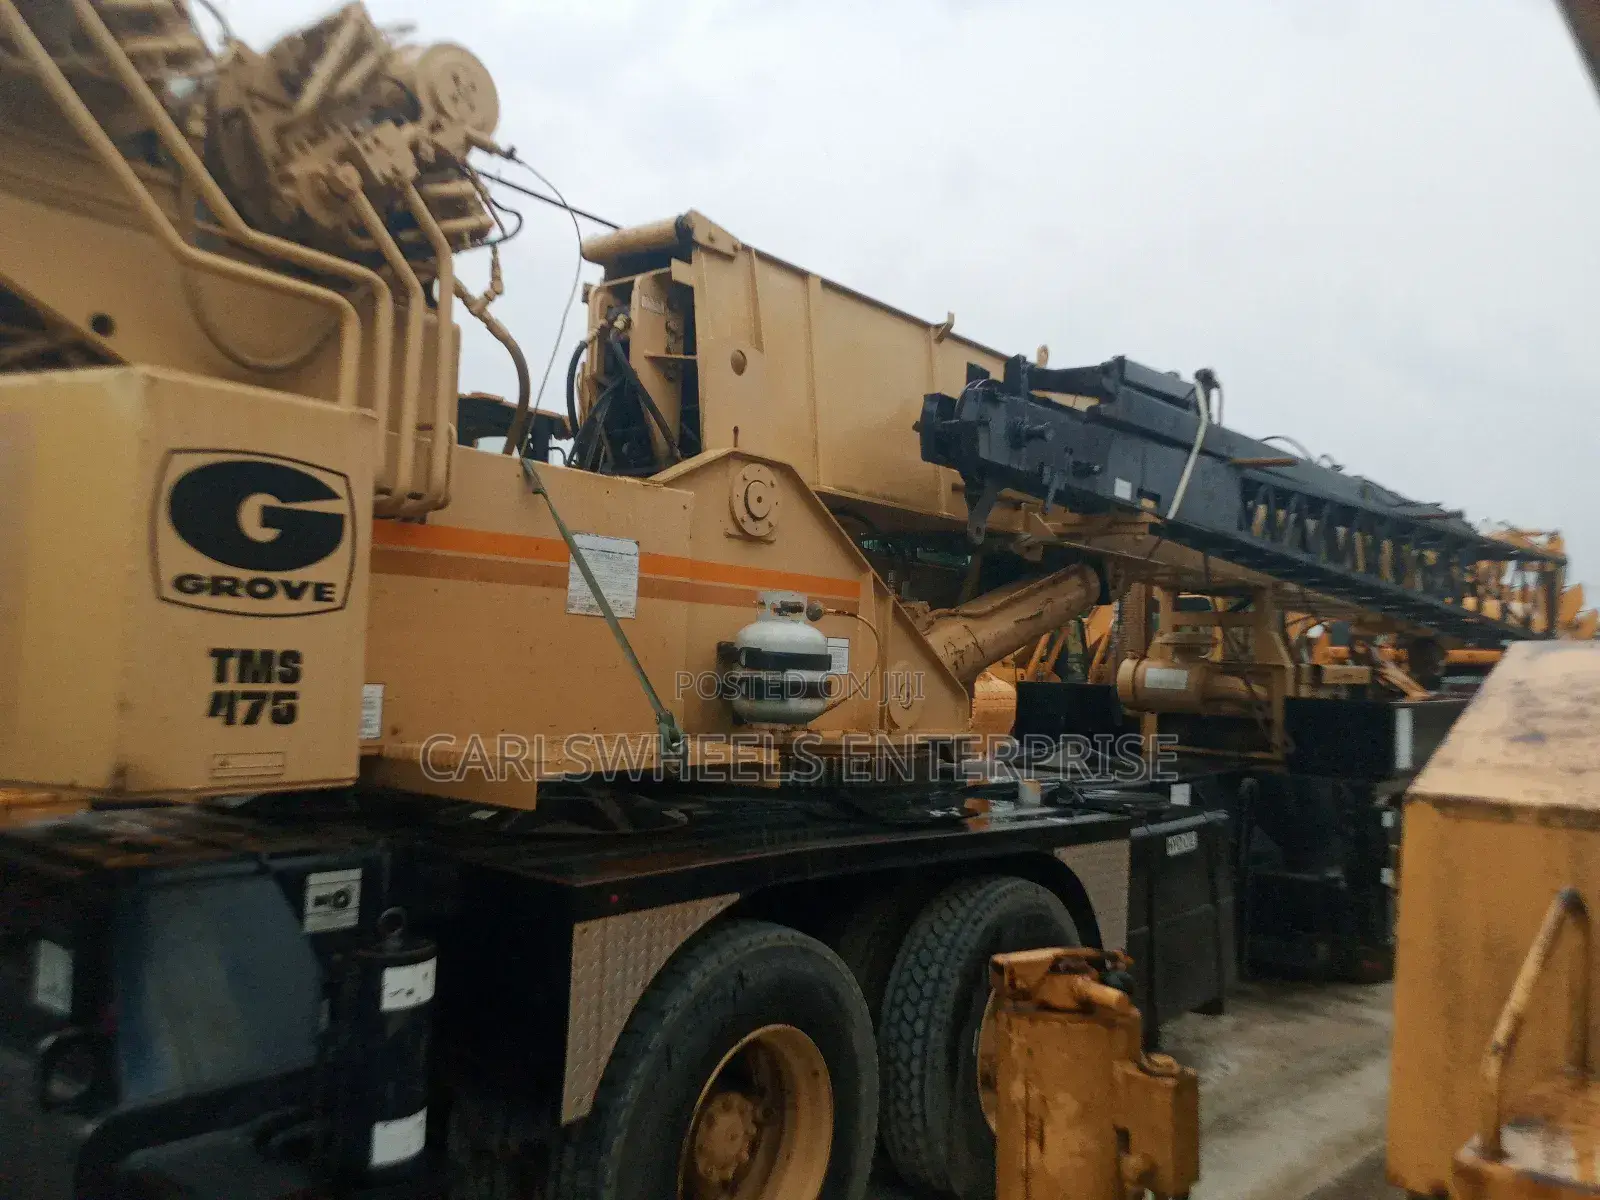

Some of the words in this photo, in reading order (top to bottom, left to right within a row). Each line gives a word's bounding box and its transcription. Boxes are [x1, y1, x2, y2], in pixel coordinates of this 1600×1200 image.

[167, 460, 348, 572] G
[172, 573, 337, 603] GROVE
[207, 648, 304, 685] TMS
[206, 689, 300, 726] 475
